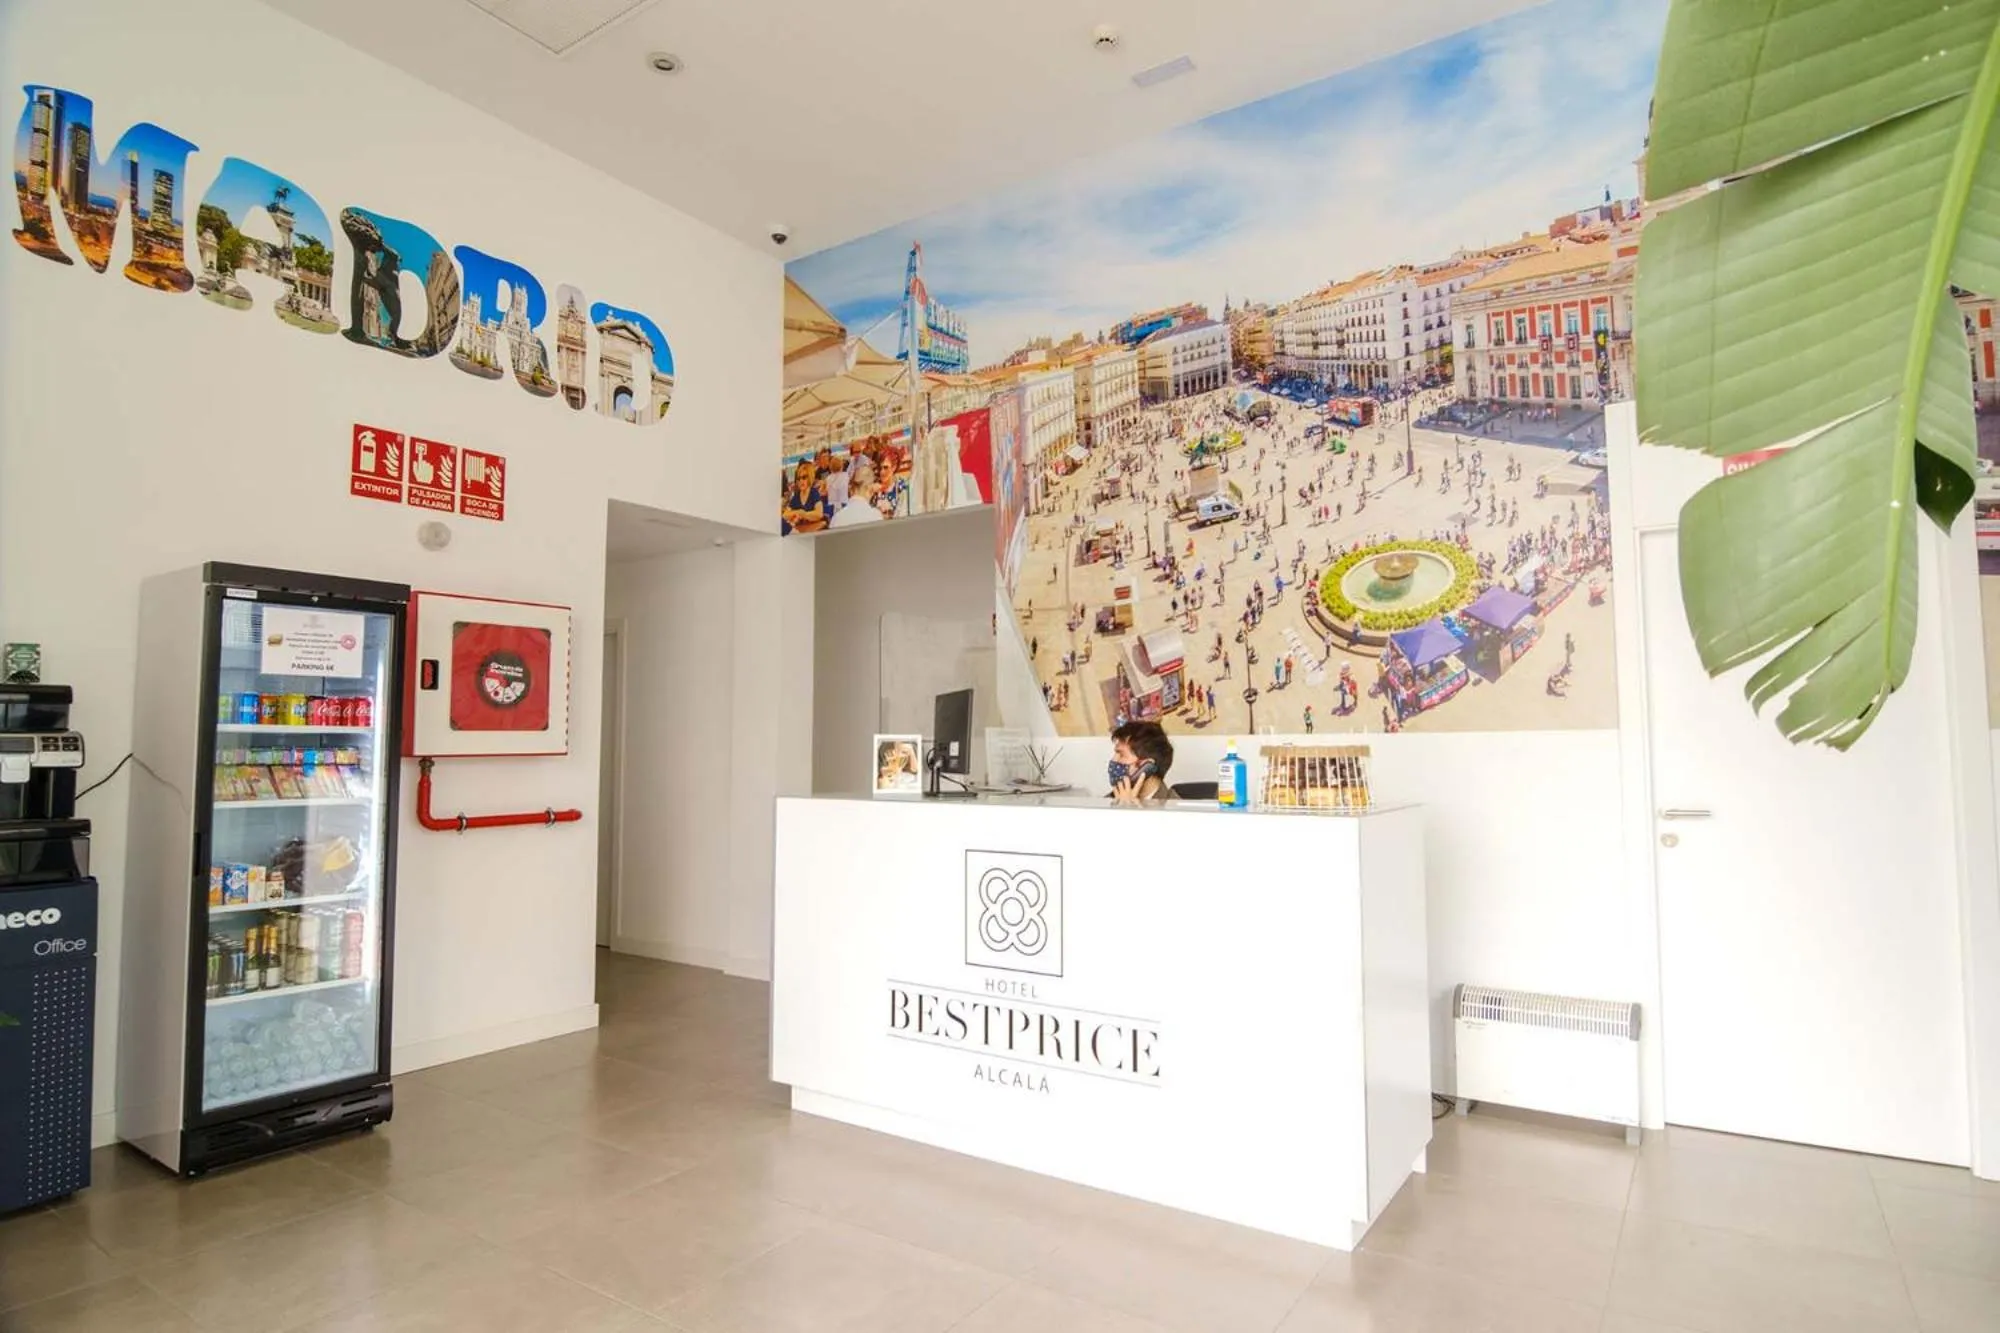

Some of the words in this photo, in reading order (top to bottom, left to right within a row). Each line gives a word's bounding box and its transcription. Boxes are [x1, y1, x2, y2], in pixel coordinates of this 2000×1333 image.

[12, 84, 676, 426] MADRID
[354, 481, 400, 496] EXTINTOR
[411, 487, 451, 501] PULSADOR
[410, 498, 421, 506] DE
[422, 499, 452, 511] ALARMA
[466, 499, 488, 509] BOCA
[488, 502, 499, 511] DE
[464, 507, 500, 520] INCENDIO
[291, 662, 325, 671] PARKING
[34, 938, 87, 956] Office
[985, 979, 1038, 998] HOTEL
[888, 989, 1160, 1077] BESTPRICE
